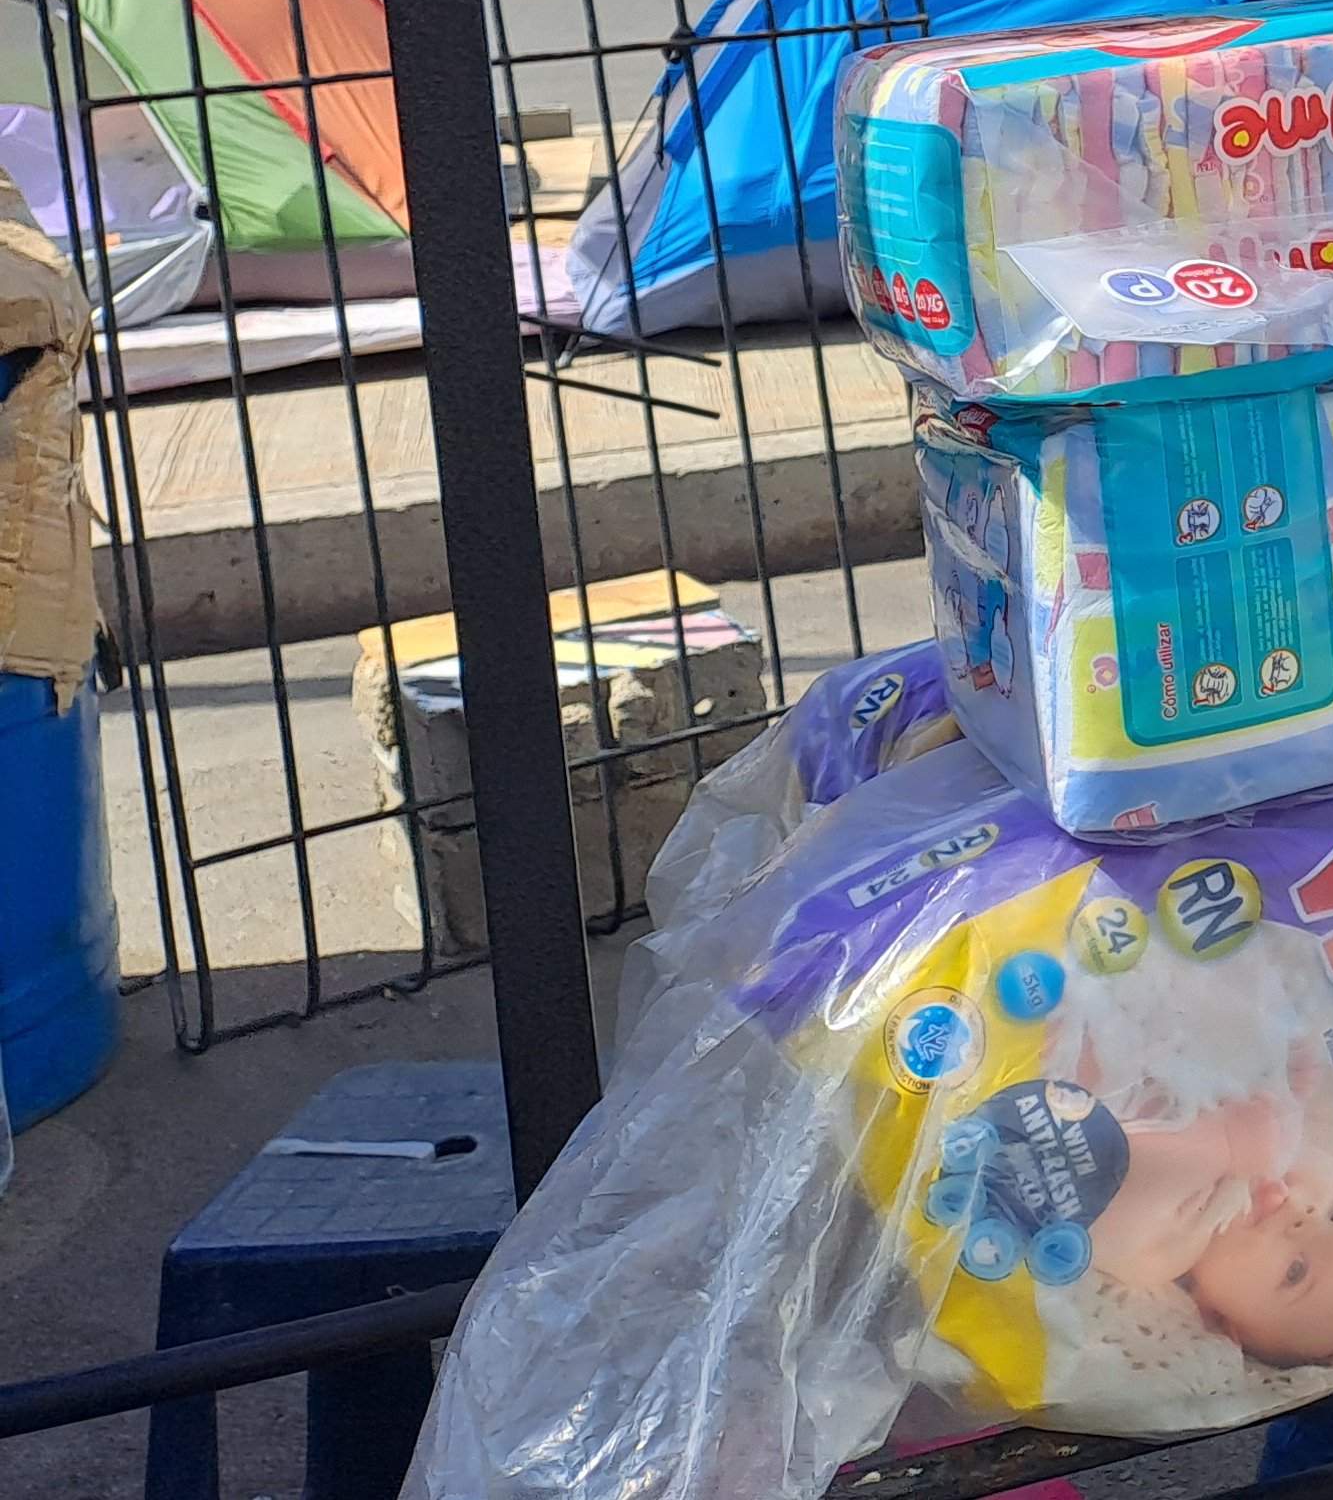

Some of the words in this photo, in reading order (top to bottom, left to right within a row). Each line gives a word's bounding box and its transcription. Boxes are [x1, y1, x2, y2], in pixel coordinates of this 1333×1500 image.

[1186, 277, 1245, 299] 20
[1157, 622, 1173, 671] utilizar
[853, 677, 899, 725] RN
[1162, 673, 1177, 719] Cómo
[926, 826, 992, 866] RN
[1096, 907, 1138, 954] 24
[1168, 862, 1254, 953] RN
[1014, 1093, 1083, 1221] ANTI-RASH
[1062, 1123, 1098, 1178] WITH
